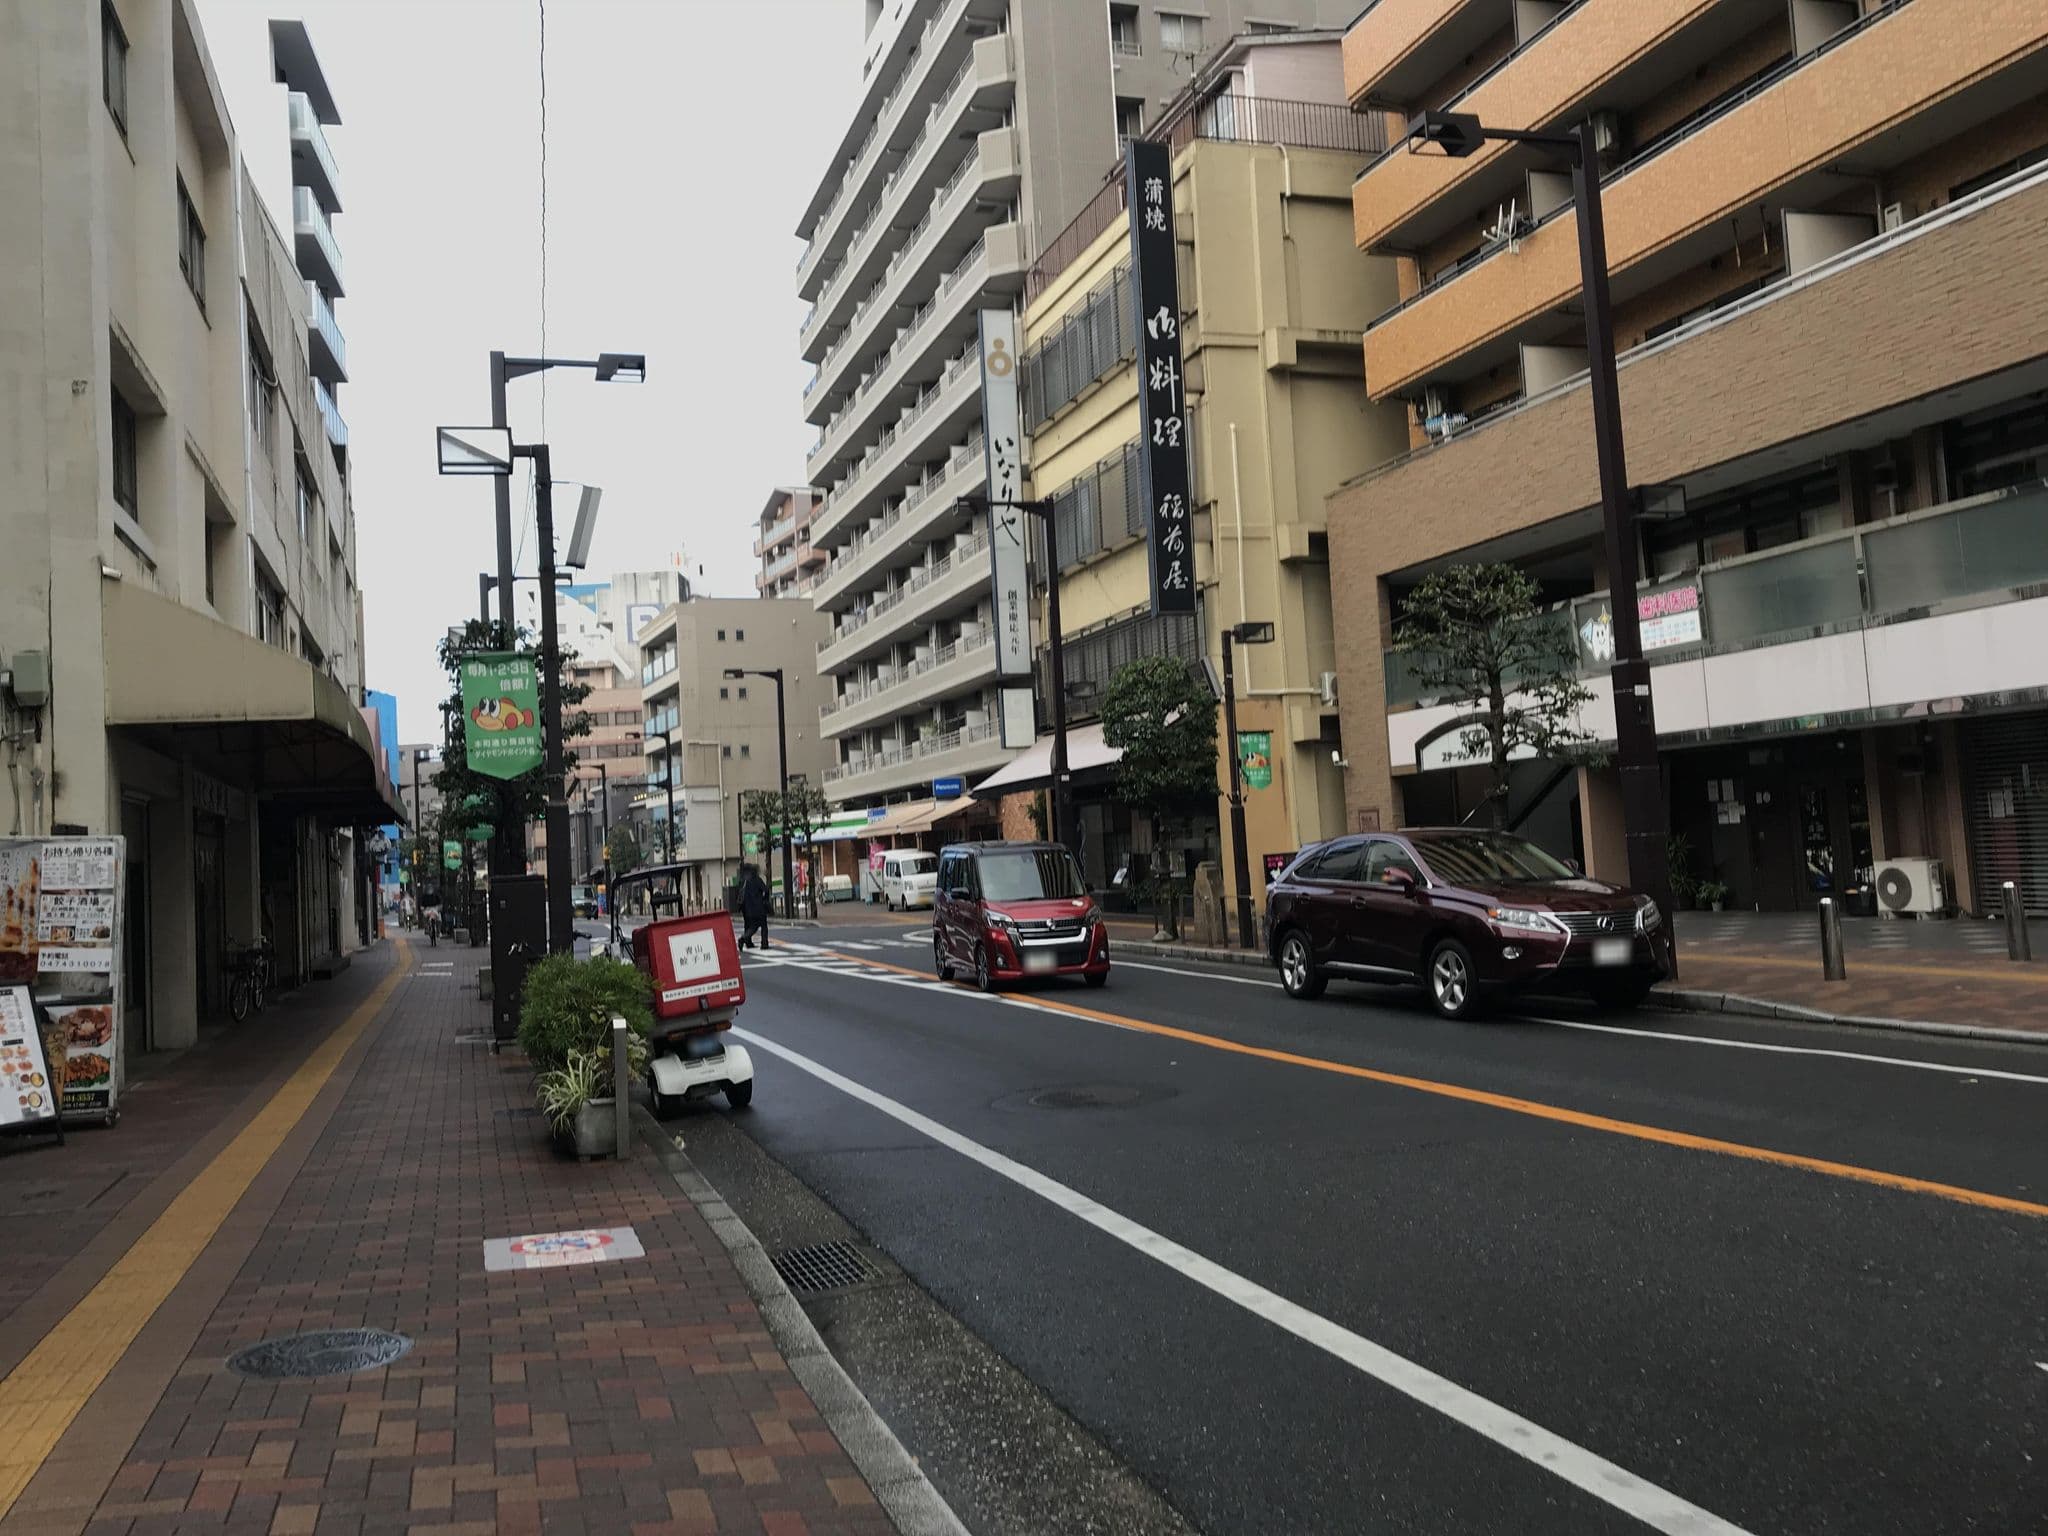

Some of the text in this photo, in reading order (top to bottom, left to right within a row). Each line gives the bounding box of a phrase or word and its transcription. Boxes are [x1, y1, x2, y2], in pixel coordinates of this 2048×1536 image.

[994, 437, 1020, 546] いなりや
[1145, 177, 1167, 232] 蒲焼
[1159, 492, 1189, 590] 稲荷屋
